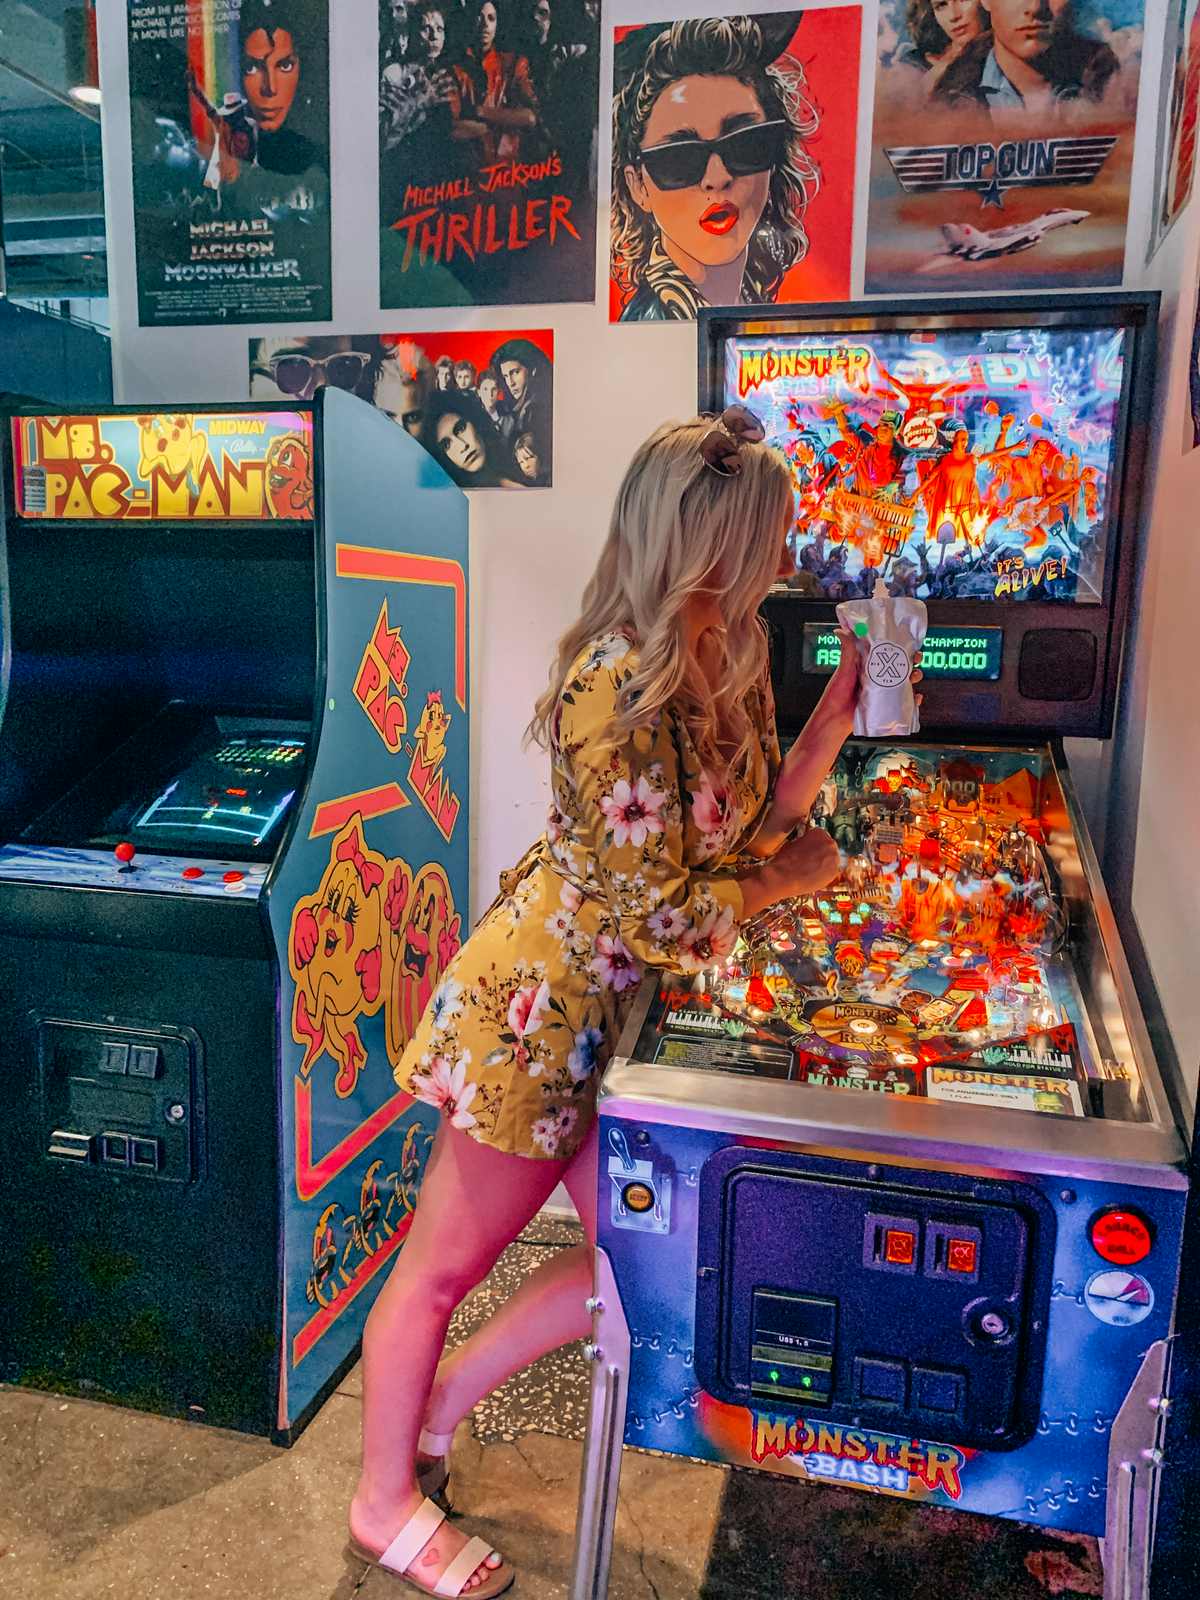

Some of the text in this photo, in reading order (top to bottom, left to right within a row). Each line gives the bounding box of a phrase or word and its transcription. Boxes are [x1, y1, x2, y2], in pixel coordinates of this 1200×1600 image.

[131, 17, 168, 28] MICHAEL
[132, 31, 139, 42] A
[141, 28, 168, 39] MOVIE
[944, 138, 1055, 181] TOP GUN
[403, 150, 562, 210] MICHAEL JACKSON'S
[189, 217, 275, 238] MICHAEL
[389, 194, 583, 274] THRILLER
[190, 240, 275, 260] JACKSON
[164, 258, 302, 282] MOONWALKER
[738, 346, 871, 399] MONSTER
[38, 419, 267, 461] MS. MIDWAY
[45, 466, 263, 517] PAC-MAN
[994, 554, 1067, 598] ALIVE!
[996, 556, 1025, 577] IT'S
[817, 635, 987, 649] MON CHAMPION
[816, 649, 841, 667] AS
[834, 1004, 898, 1020] MONSTERS
[932, 1068, 1072, 1097] MONSTER
[752, 1409, 963, 1500] MONSTER
[813, 1453, 908, 1491] BASH
